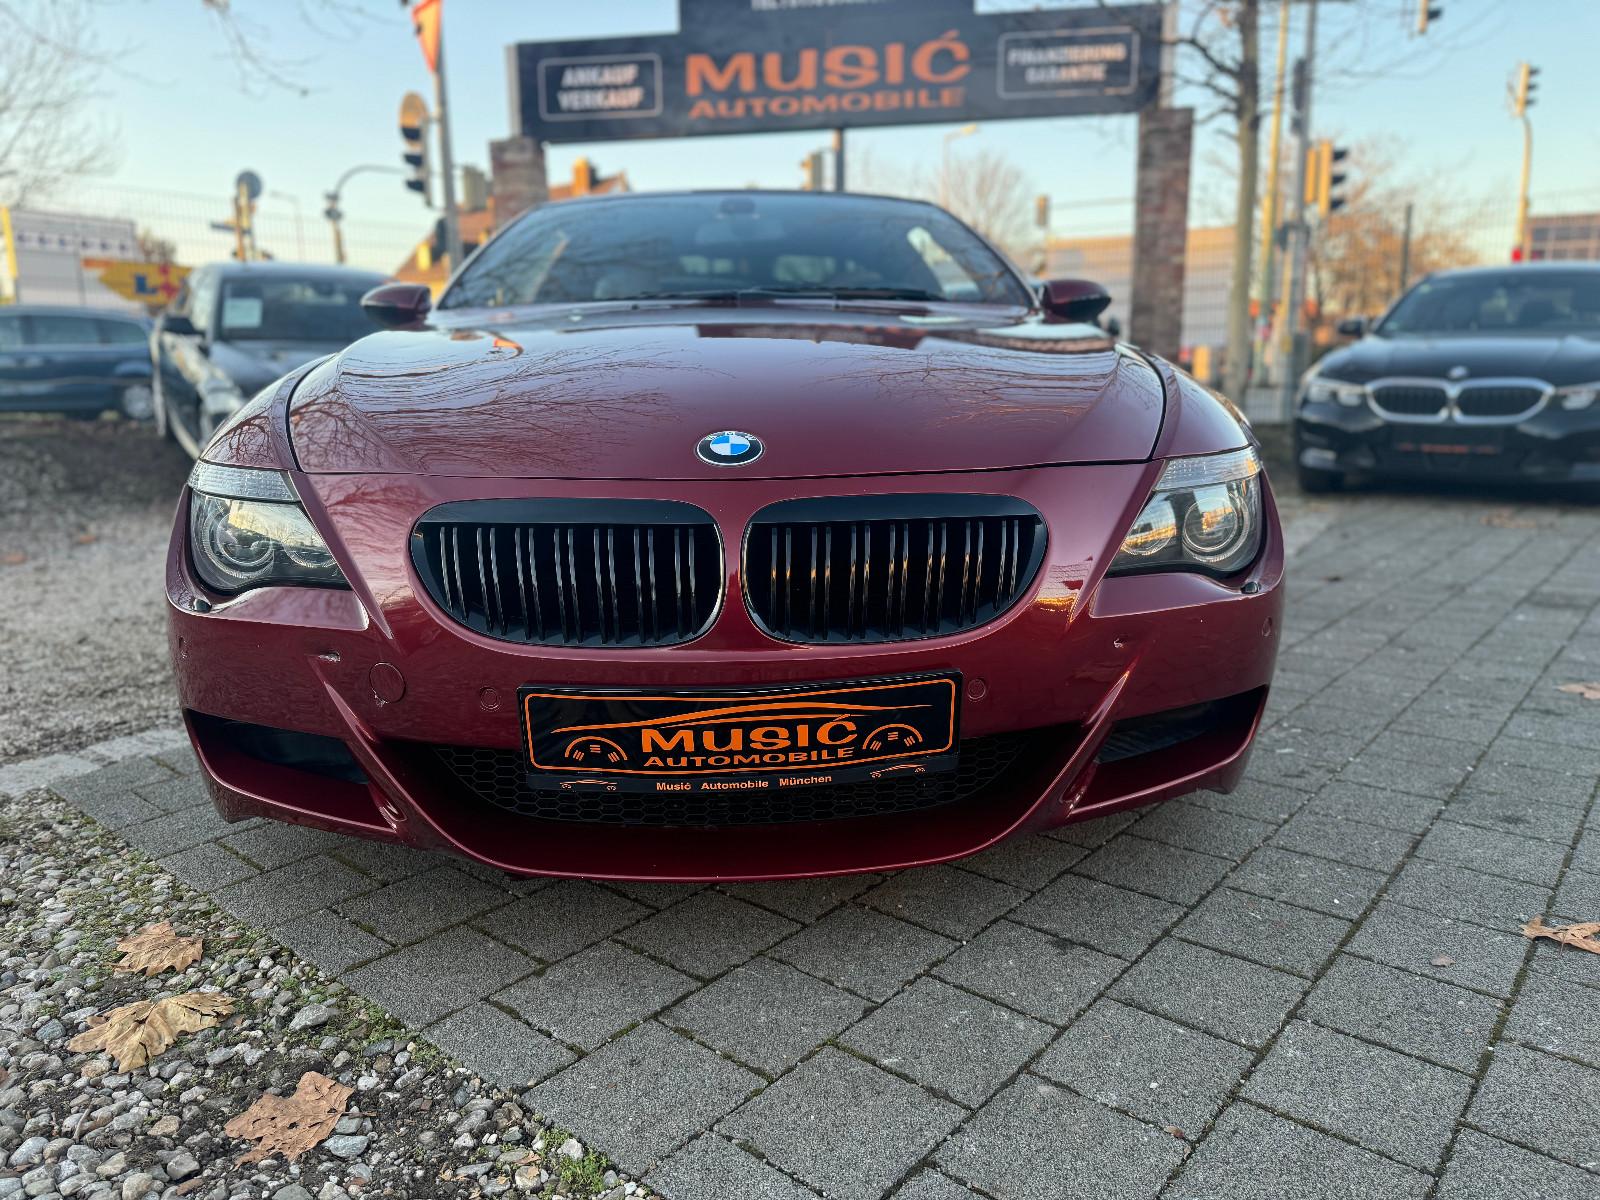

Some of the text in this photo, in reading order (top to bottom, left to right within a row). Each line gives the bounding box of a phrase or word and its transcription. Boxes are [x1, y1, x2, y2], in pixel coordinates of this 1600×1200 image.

[684, 29, 971, 96] MUSIĆ
[560, 63, 639, 89] ANKAUF
[556, 86, 645, 112] VERKAUF
[688, 86, 966, 119] AUTOMOBILE
[641, 713, 858, 753] MUSIĆ
[643, 747, 856, 767] AUTOMOBILE
[701, 780, 769, 790] Automobile
[779, 775, 832, 787] München
